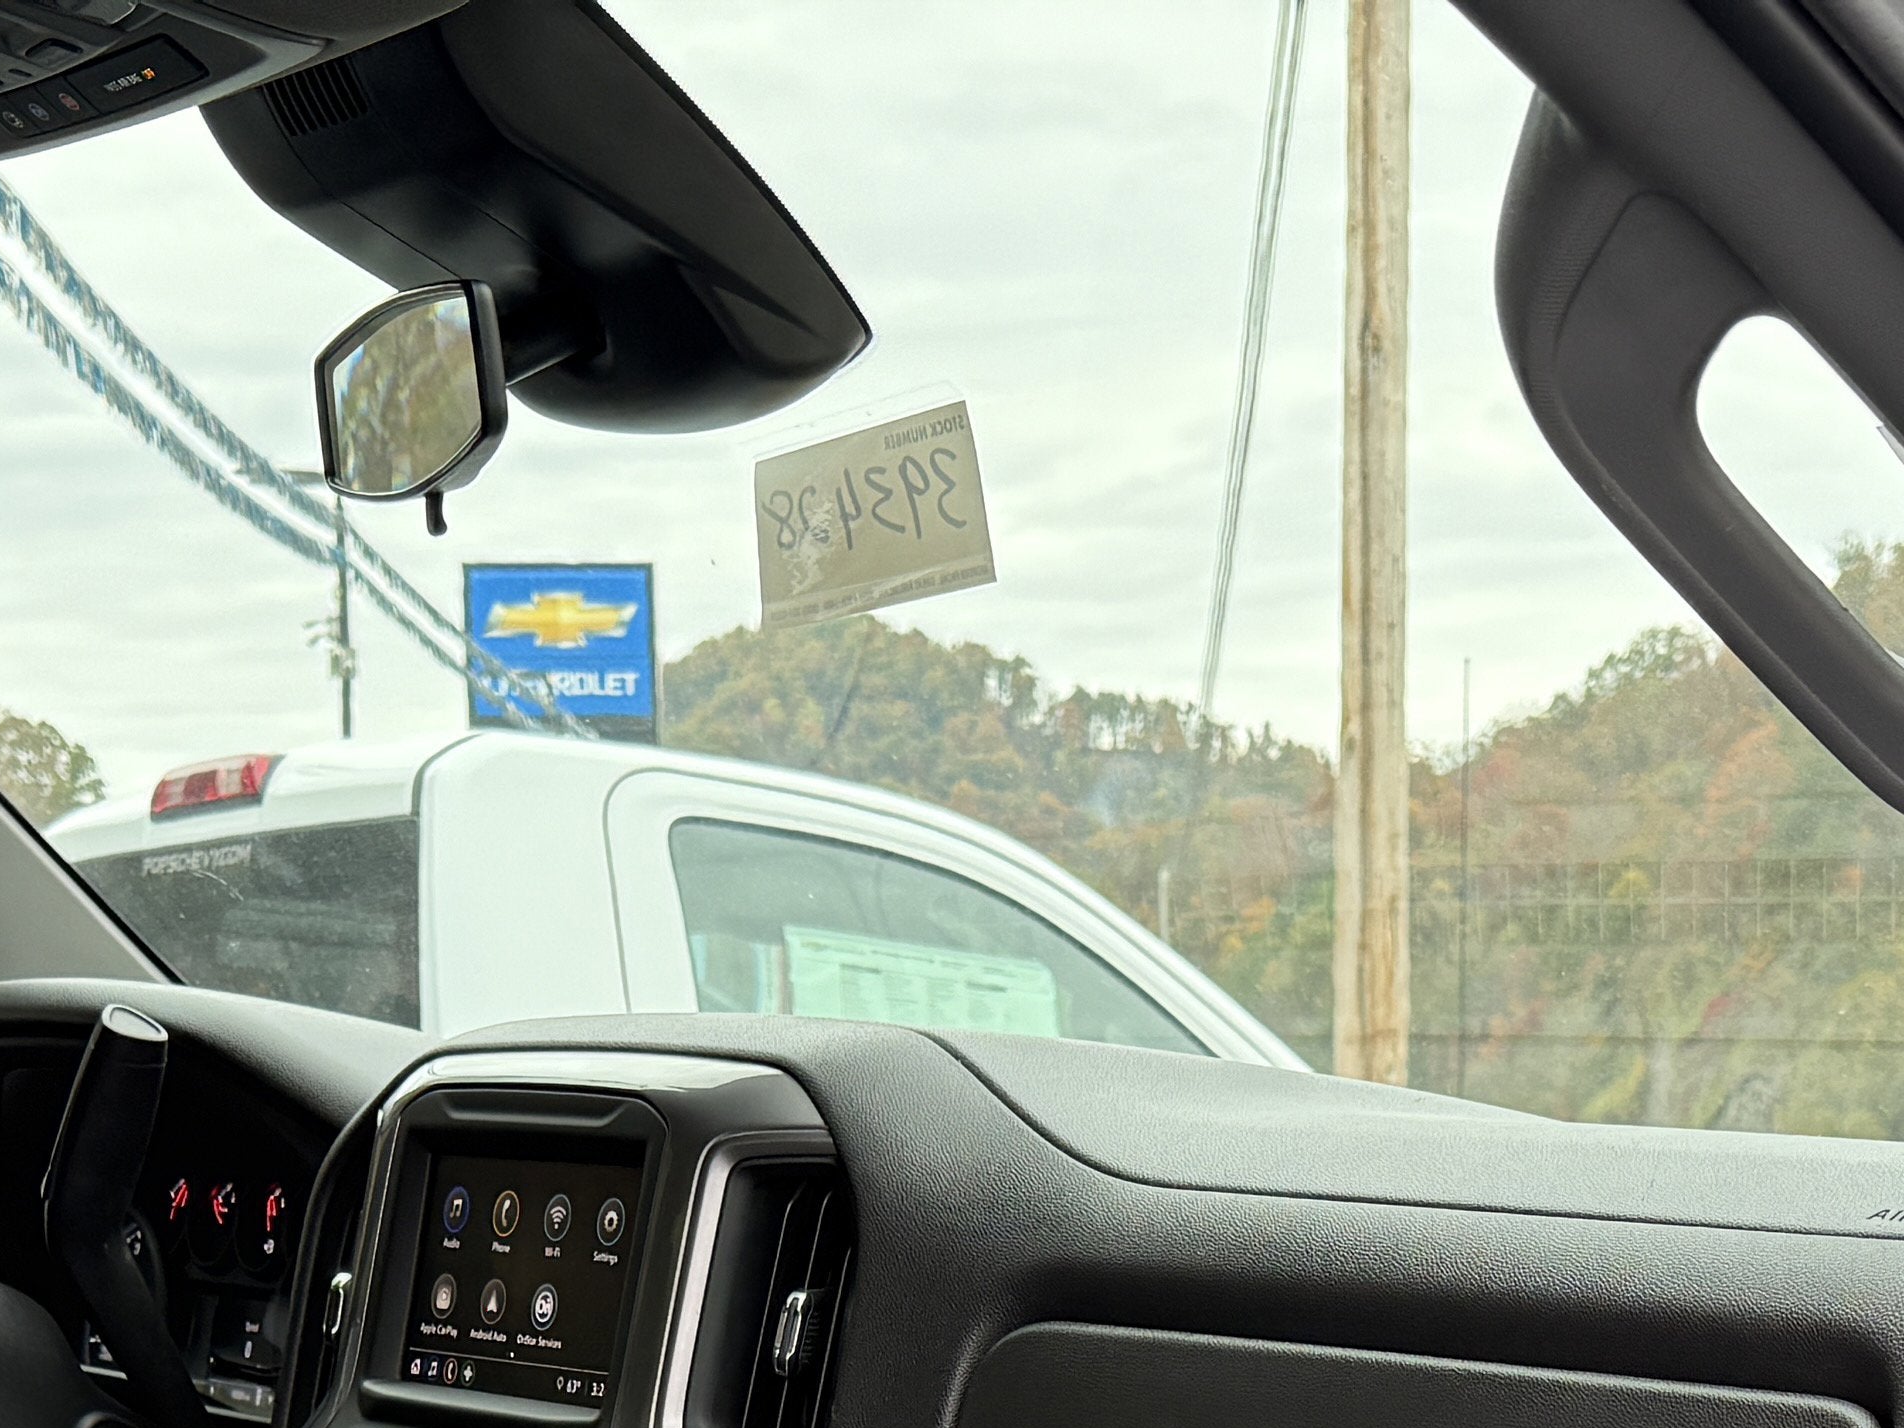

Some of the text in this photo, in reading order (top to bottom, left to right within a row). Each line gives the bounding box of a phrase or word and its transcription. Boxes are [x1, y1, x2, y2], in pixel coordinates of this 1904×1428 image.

[443, 1238, 460, 1249] Audio
[491, 1241, 511, 1253] Phone
[593, 1251, 618, 1265] Settings
[420, 1322, 436, 1335] Apple
[470, 1329, 507, 1342] Android Auto
[538, 1336, 562, 1349] Services
